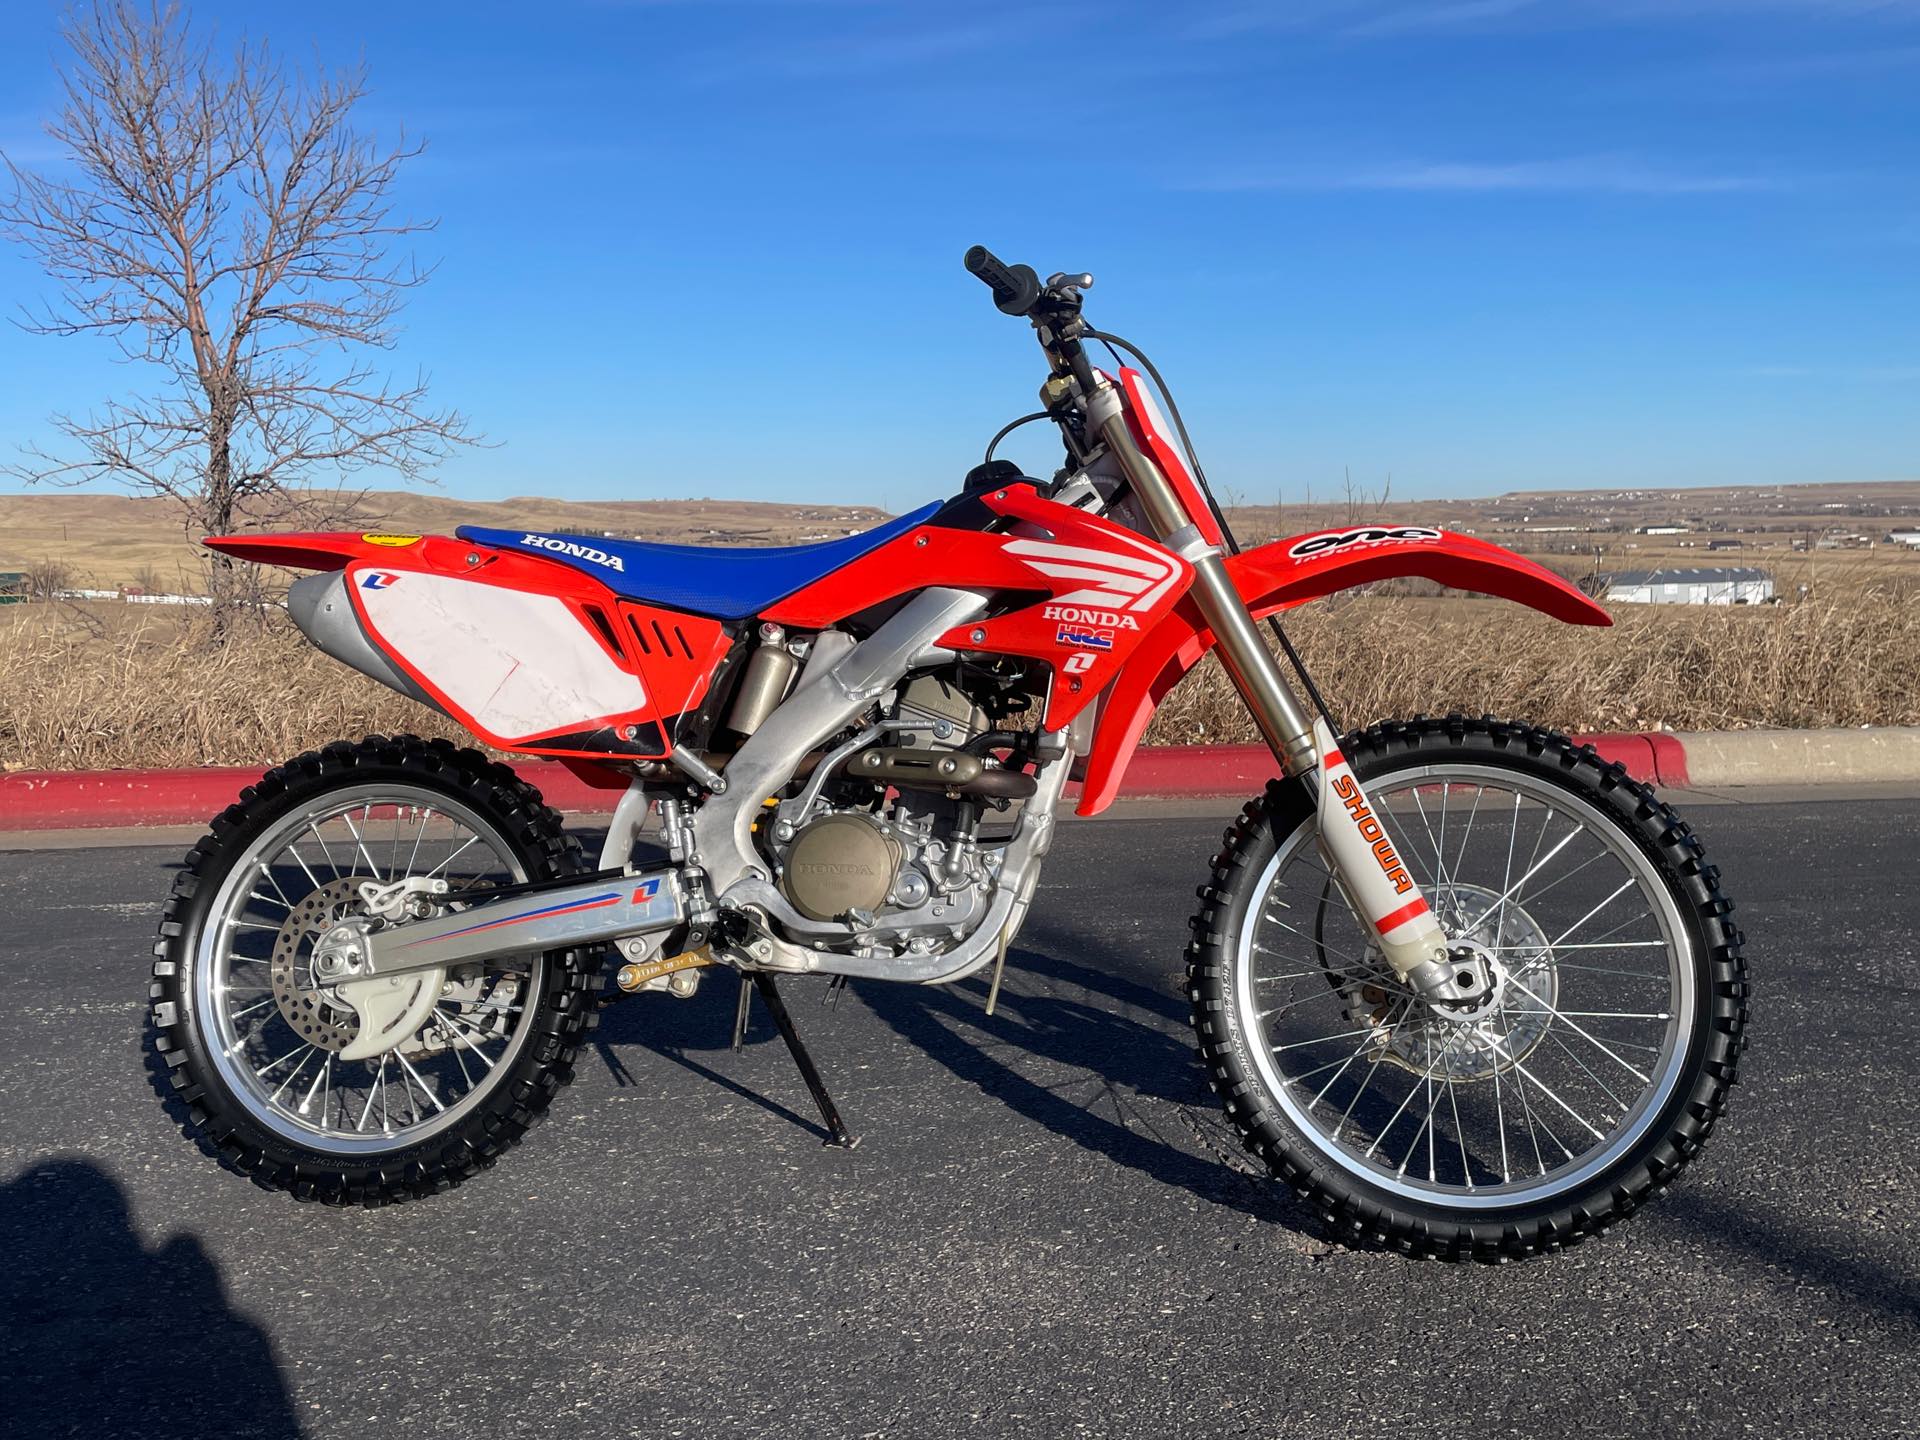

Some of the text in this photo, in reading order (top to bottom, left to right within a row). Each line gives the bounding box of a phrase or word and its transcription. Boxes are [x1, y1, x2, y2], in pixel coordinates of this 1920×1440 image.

[520, 534, 624, 572] HONDA
[1042, 606, 1140, 631] HONDA
[1056, 623, 1114, 648] HRC
[1056, 640, 1112, 653] HONDA RACING
[1331, 774, 1413, 895] SHOWA
[800, 864, 874, 876] HONDA
